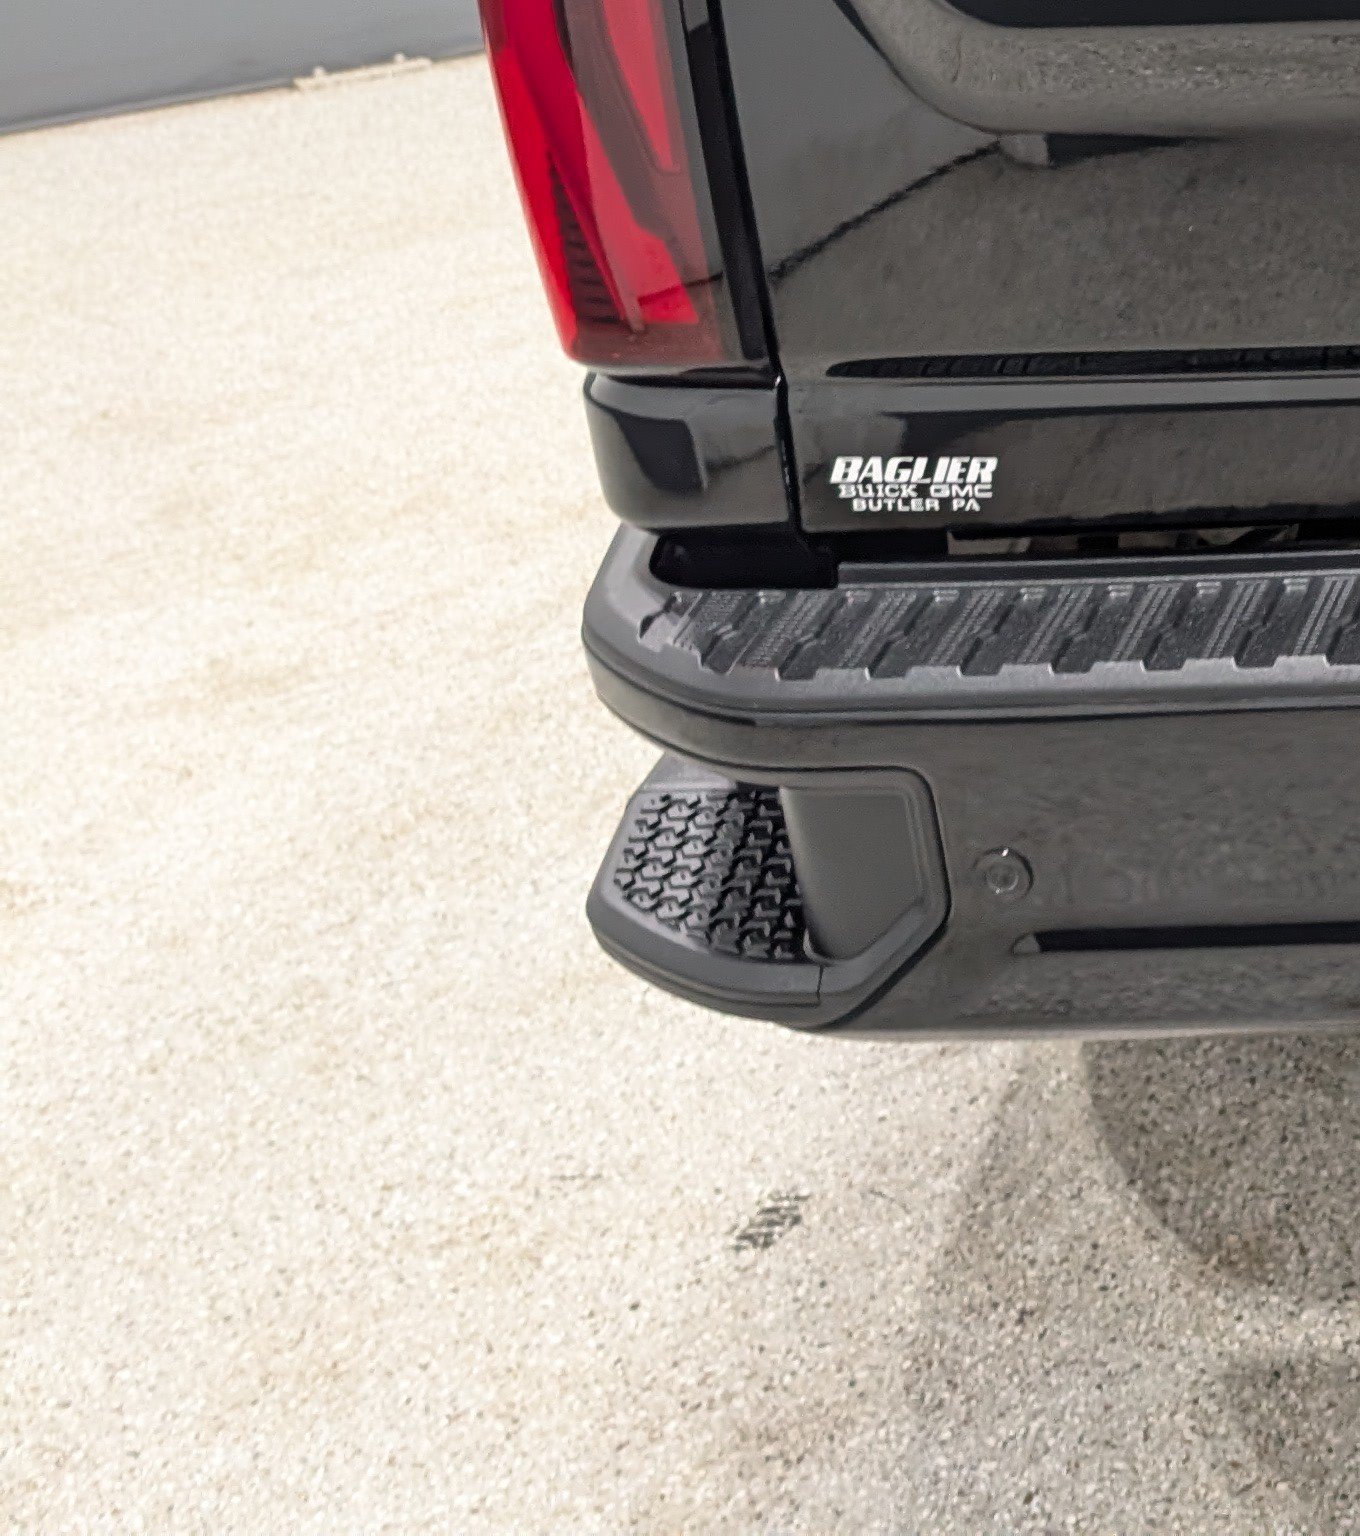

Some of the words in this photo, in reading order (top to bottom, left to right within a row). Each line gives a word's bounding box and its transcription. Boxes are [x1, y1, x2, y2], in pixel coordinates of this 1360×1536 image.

[830, 455, 999, 484] BAGLIER
[838, 483, 919, 498] BUICK
[930, 483, 994, 498] GMC
[852, 497, 941, 513] BUTLER
[952, 497, 982, 513] PA
